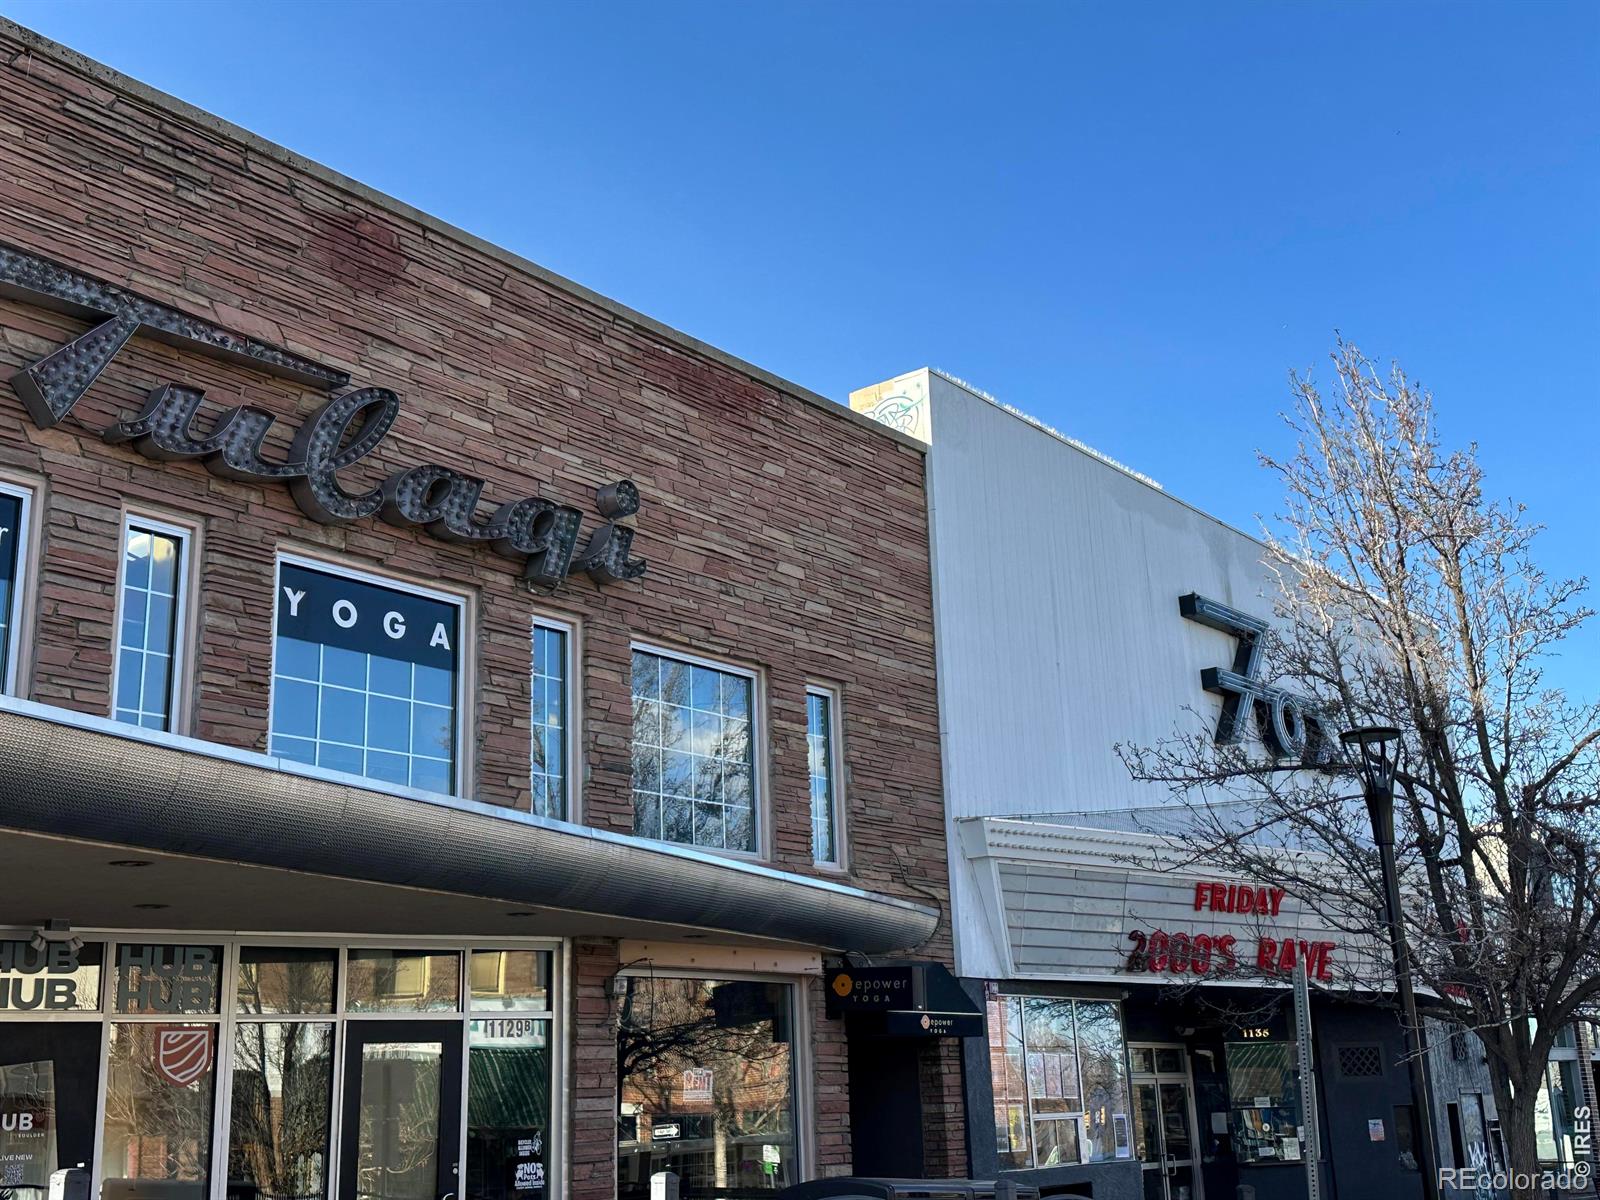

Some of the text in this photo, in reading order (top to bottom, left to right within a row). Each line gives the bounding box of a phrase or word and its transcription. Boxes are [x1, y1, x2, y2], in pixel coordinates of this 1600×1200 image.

[283, 586, 451, 651] YOGA
[1194, 881, 1286, 917] FRIDAY
[120, 945, 214, 977] HUB
[1126, 929, 1336, 981] 2000'S RAVE
[117, 979, 211, 1011] HUB
[853, 994, 891, 1003] YOGA
[523, 1162, 537, 1174] NO
